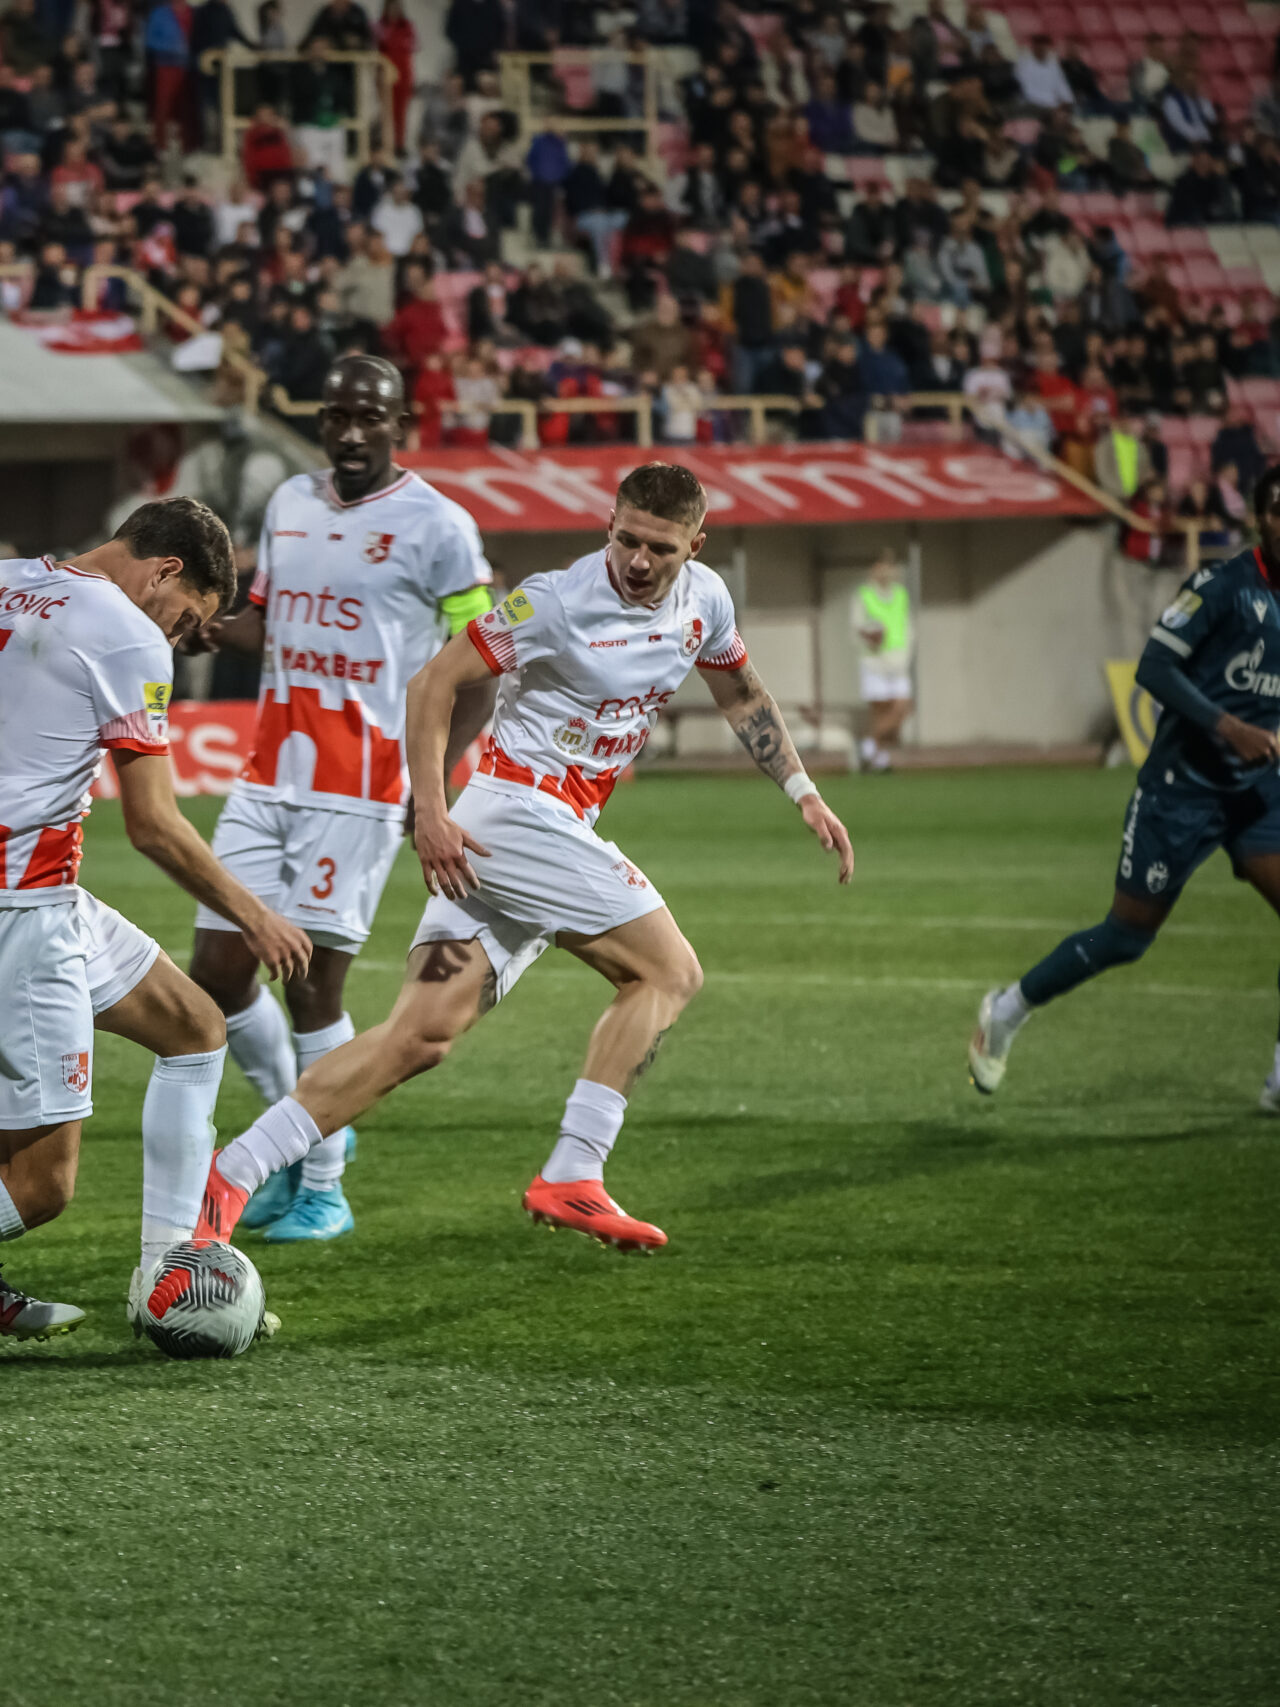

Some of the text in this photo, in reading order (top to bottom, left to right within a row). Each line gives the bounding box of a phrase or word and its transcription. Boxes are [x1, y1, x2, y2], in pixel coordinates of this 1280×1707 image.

[724, 450, 1060, 510] mts
[275, 586, 364, 632] mts
[281, 646, 384, 684] MAXBET
[311, 857, 336, 899] 3
